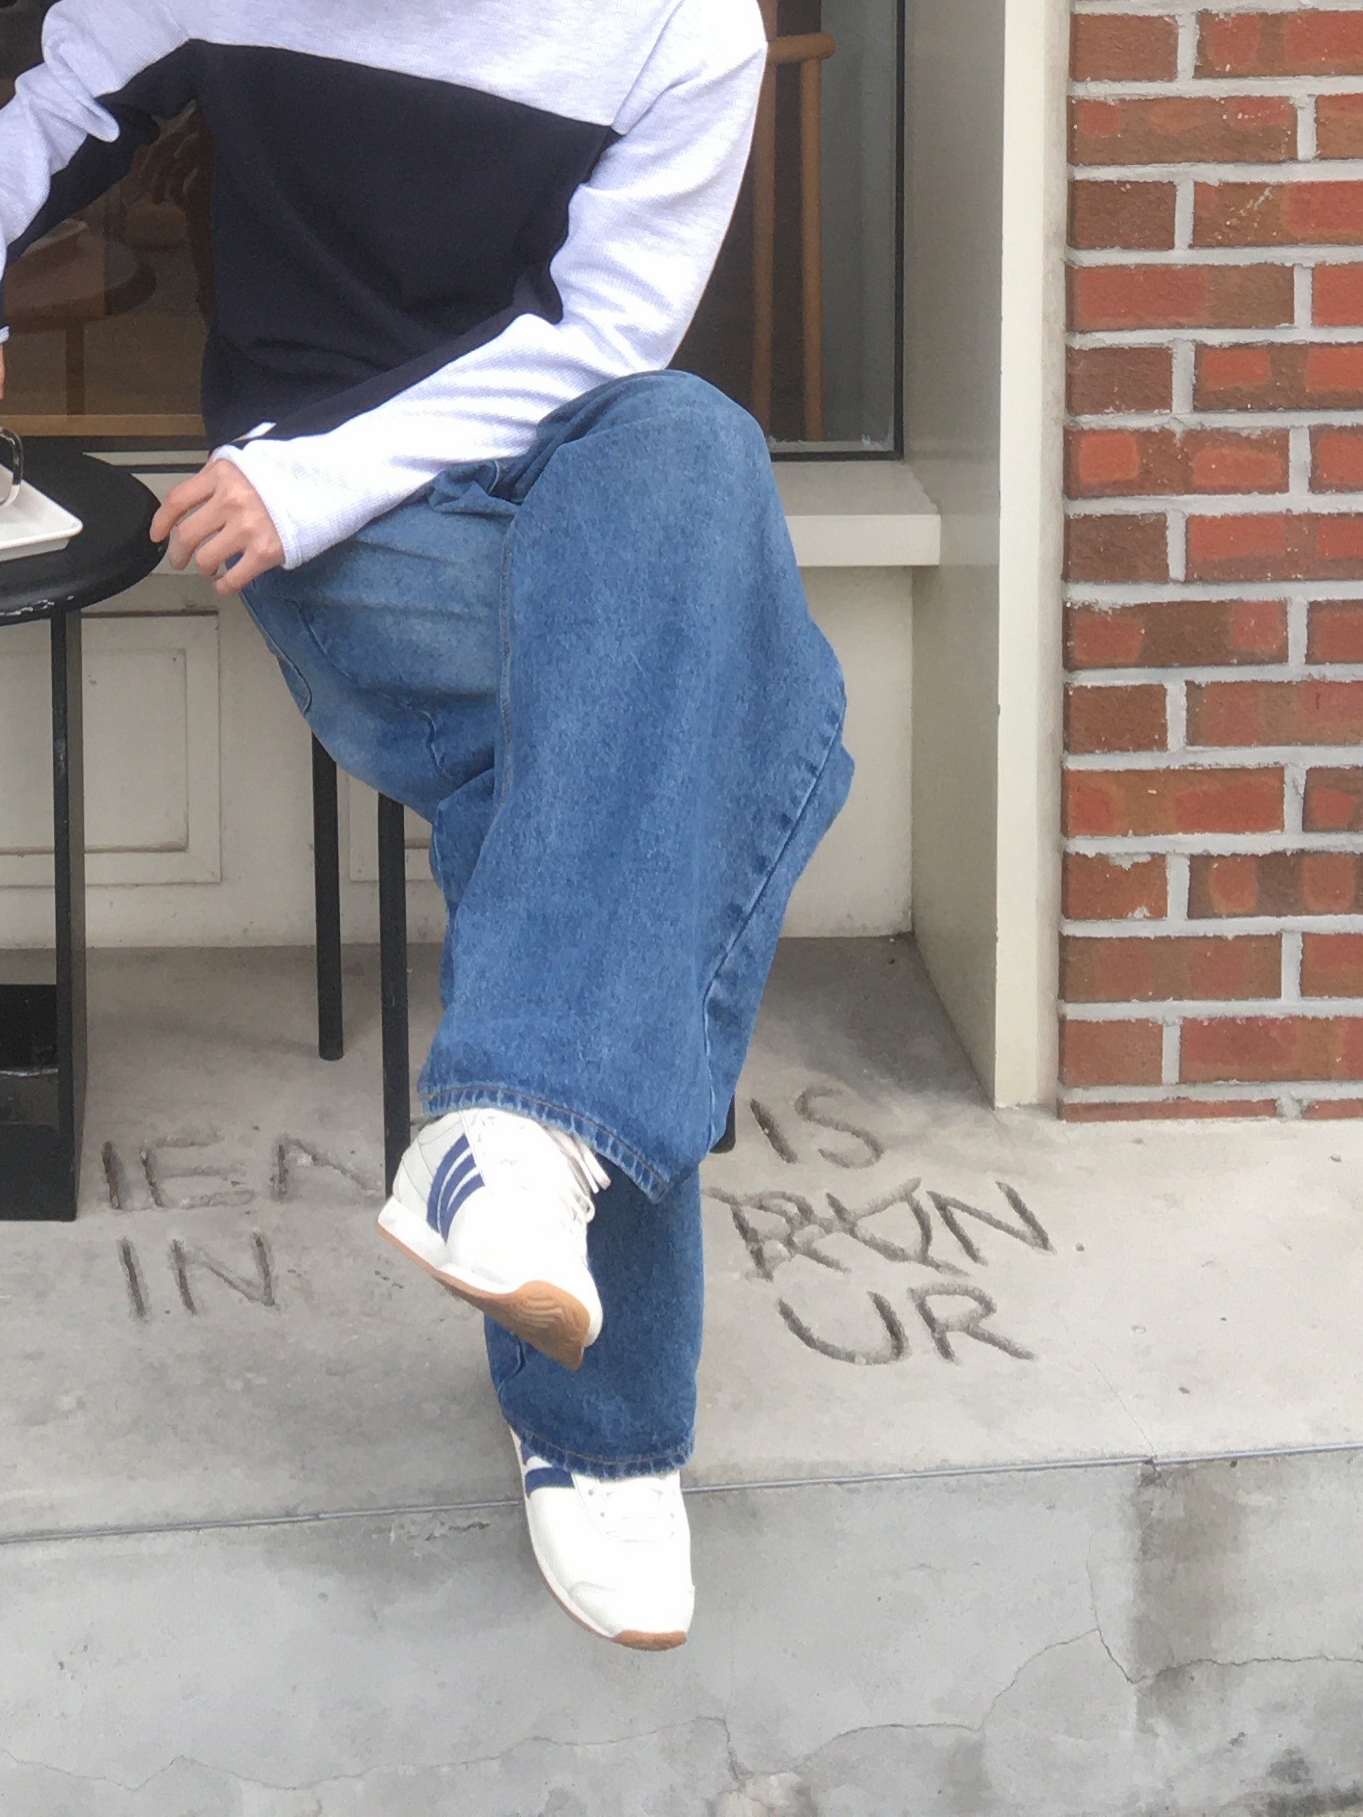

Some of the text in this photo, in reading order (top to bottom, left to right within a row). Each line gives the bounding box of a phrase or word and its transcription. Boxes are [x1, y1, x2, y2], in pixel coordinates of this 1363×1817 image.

[749, 1084, 885, 1169] IS
[116, 1229, 278, 1321] IN
[777, 1282, 1038, 1366] UR
